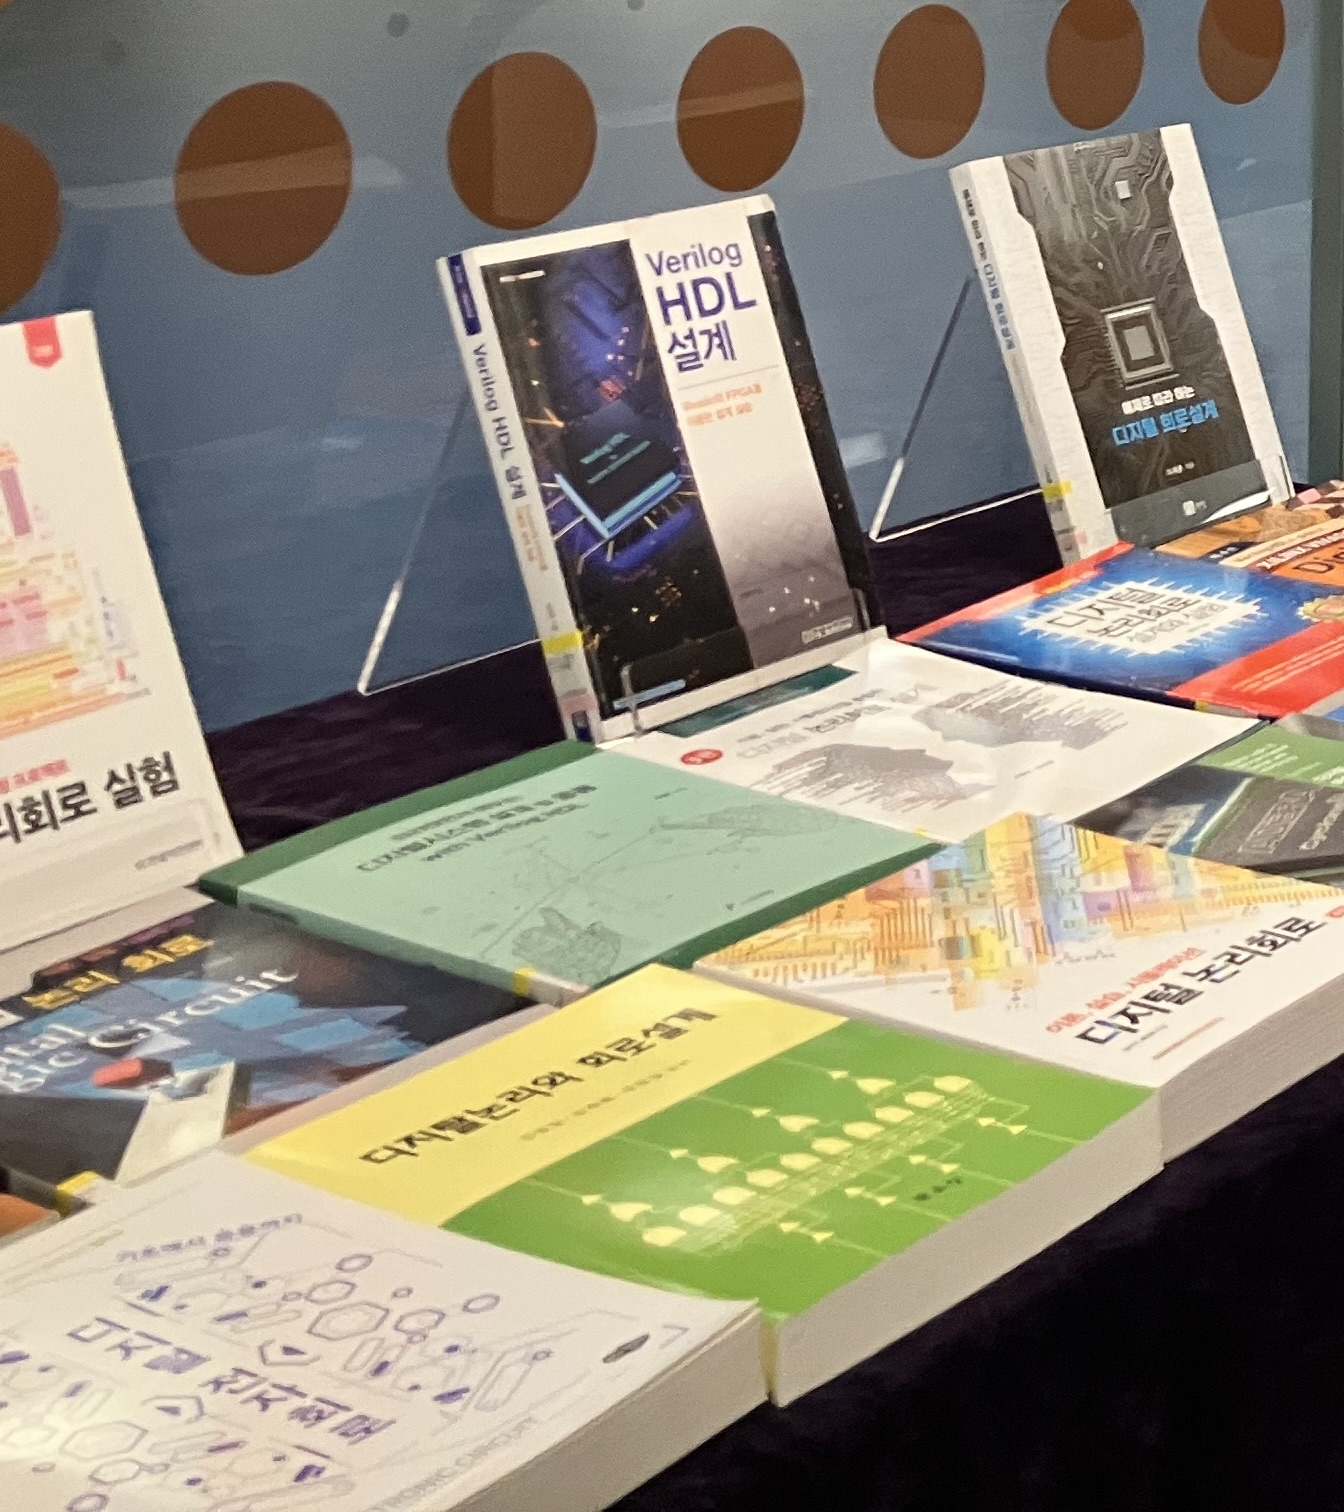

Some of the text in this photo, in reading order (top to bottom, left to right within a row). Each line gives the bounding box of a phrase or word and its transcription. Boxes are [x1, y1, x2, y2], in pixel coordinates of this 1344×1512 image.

[645, 241, 743, 279] Verilog
[655, 271, 757, 326] HDL
[667, 321, 738, 373] 설계
[465, 343, 519, 461] Verilog HDL
[1112, 399, 1219, 446] 디지털 회로설계
[1047, 587, 1166, 628] 디지털
[1088, 598, 1202, 638] 논리회로
[103, 750, 180, 811] 실험
[1075, 916, 1327, 1044] 디지털 논리회로
[89, 969, 300, 1048] Circuit
